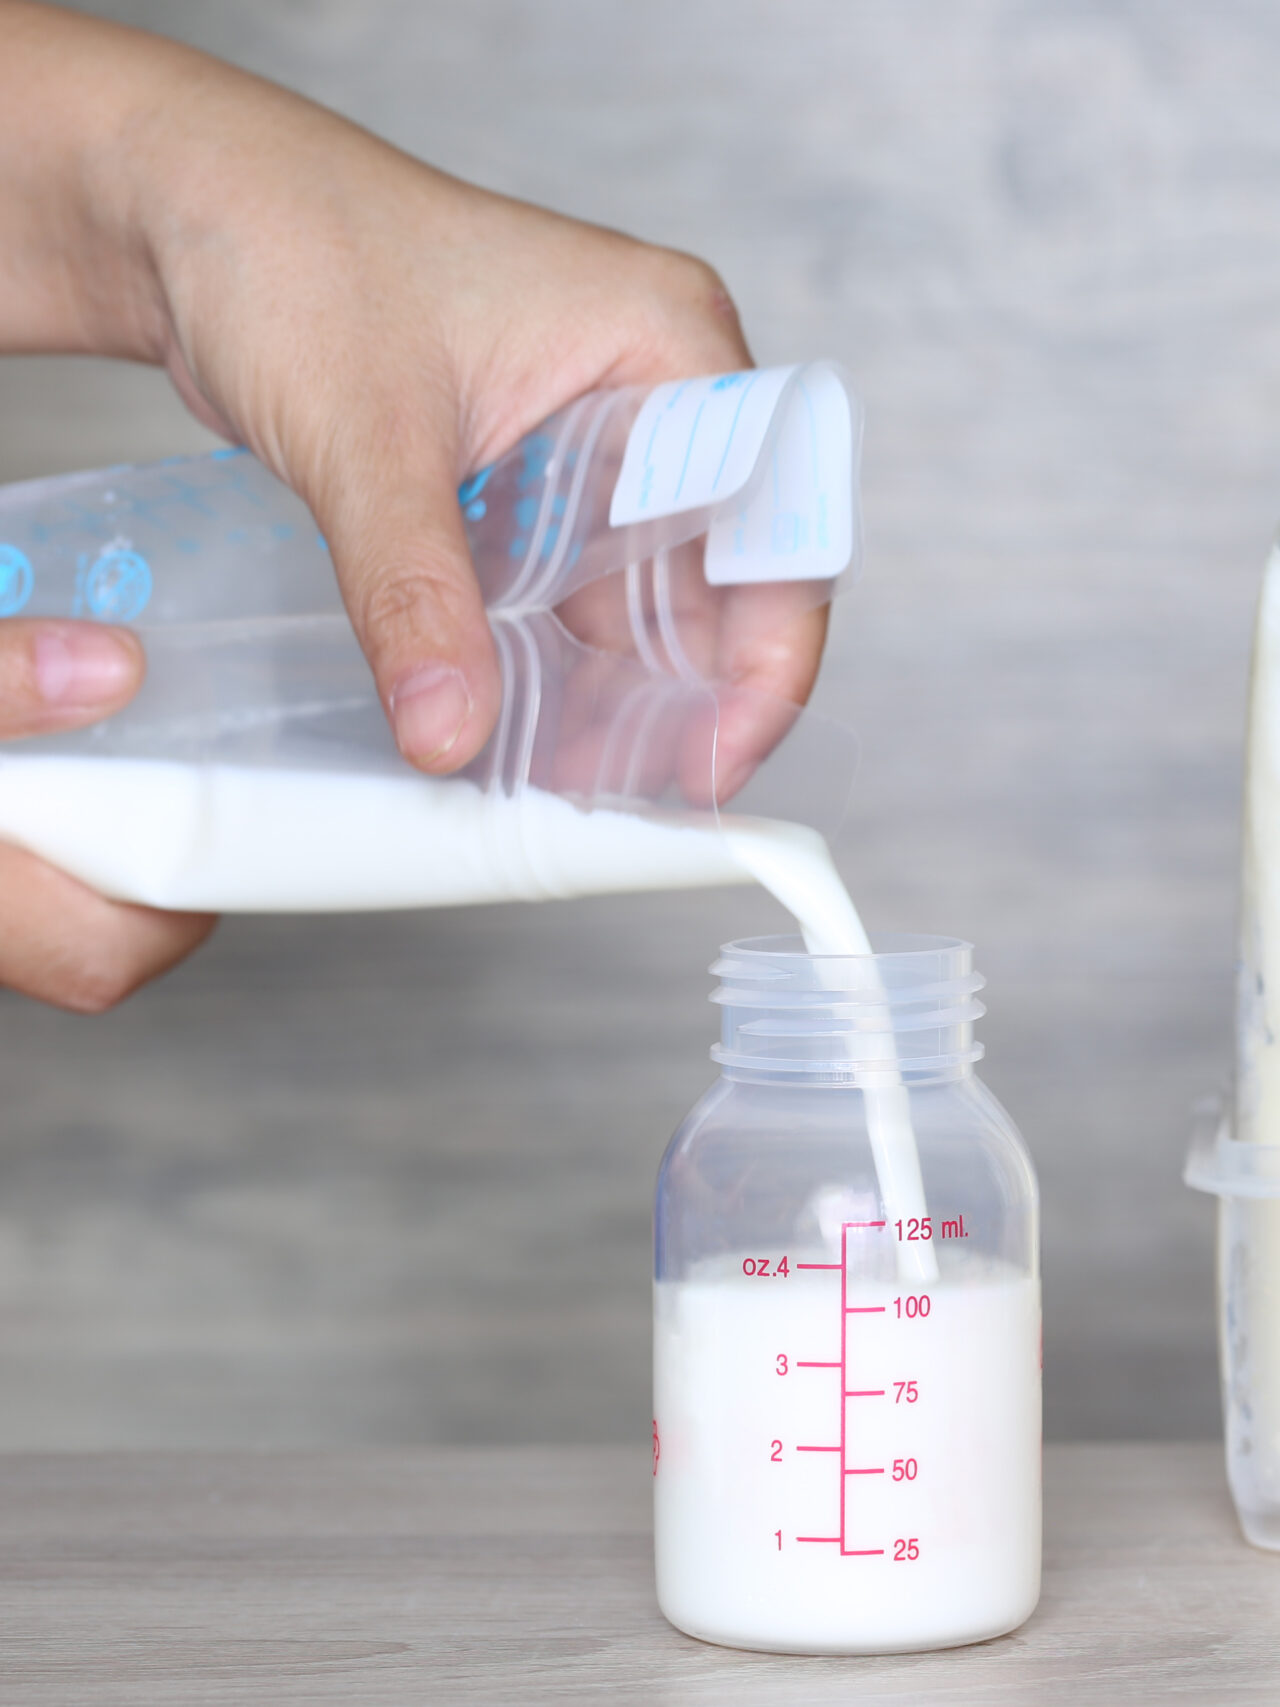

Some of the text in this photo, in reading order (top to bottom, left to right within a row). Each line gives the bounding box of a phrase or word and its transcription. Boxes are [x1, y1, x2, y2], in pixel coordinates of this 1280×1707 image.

[894, 1214, 970, 1242] 125 ml.
[742, 1256, 791, 1279] oz.4
[892, 1294, 932, 1319] 100
[775, 1353, 789, 1377] 3
[892, 1380, 919, 1404] 75
[770, 1439, 784, 1463] 2
[891, 1458, 919, 1482] 50
[773, 1529, 784, 1552] 1
[892, 1538, 920, 1562] 25
